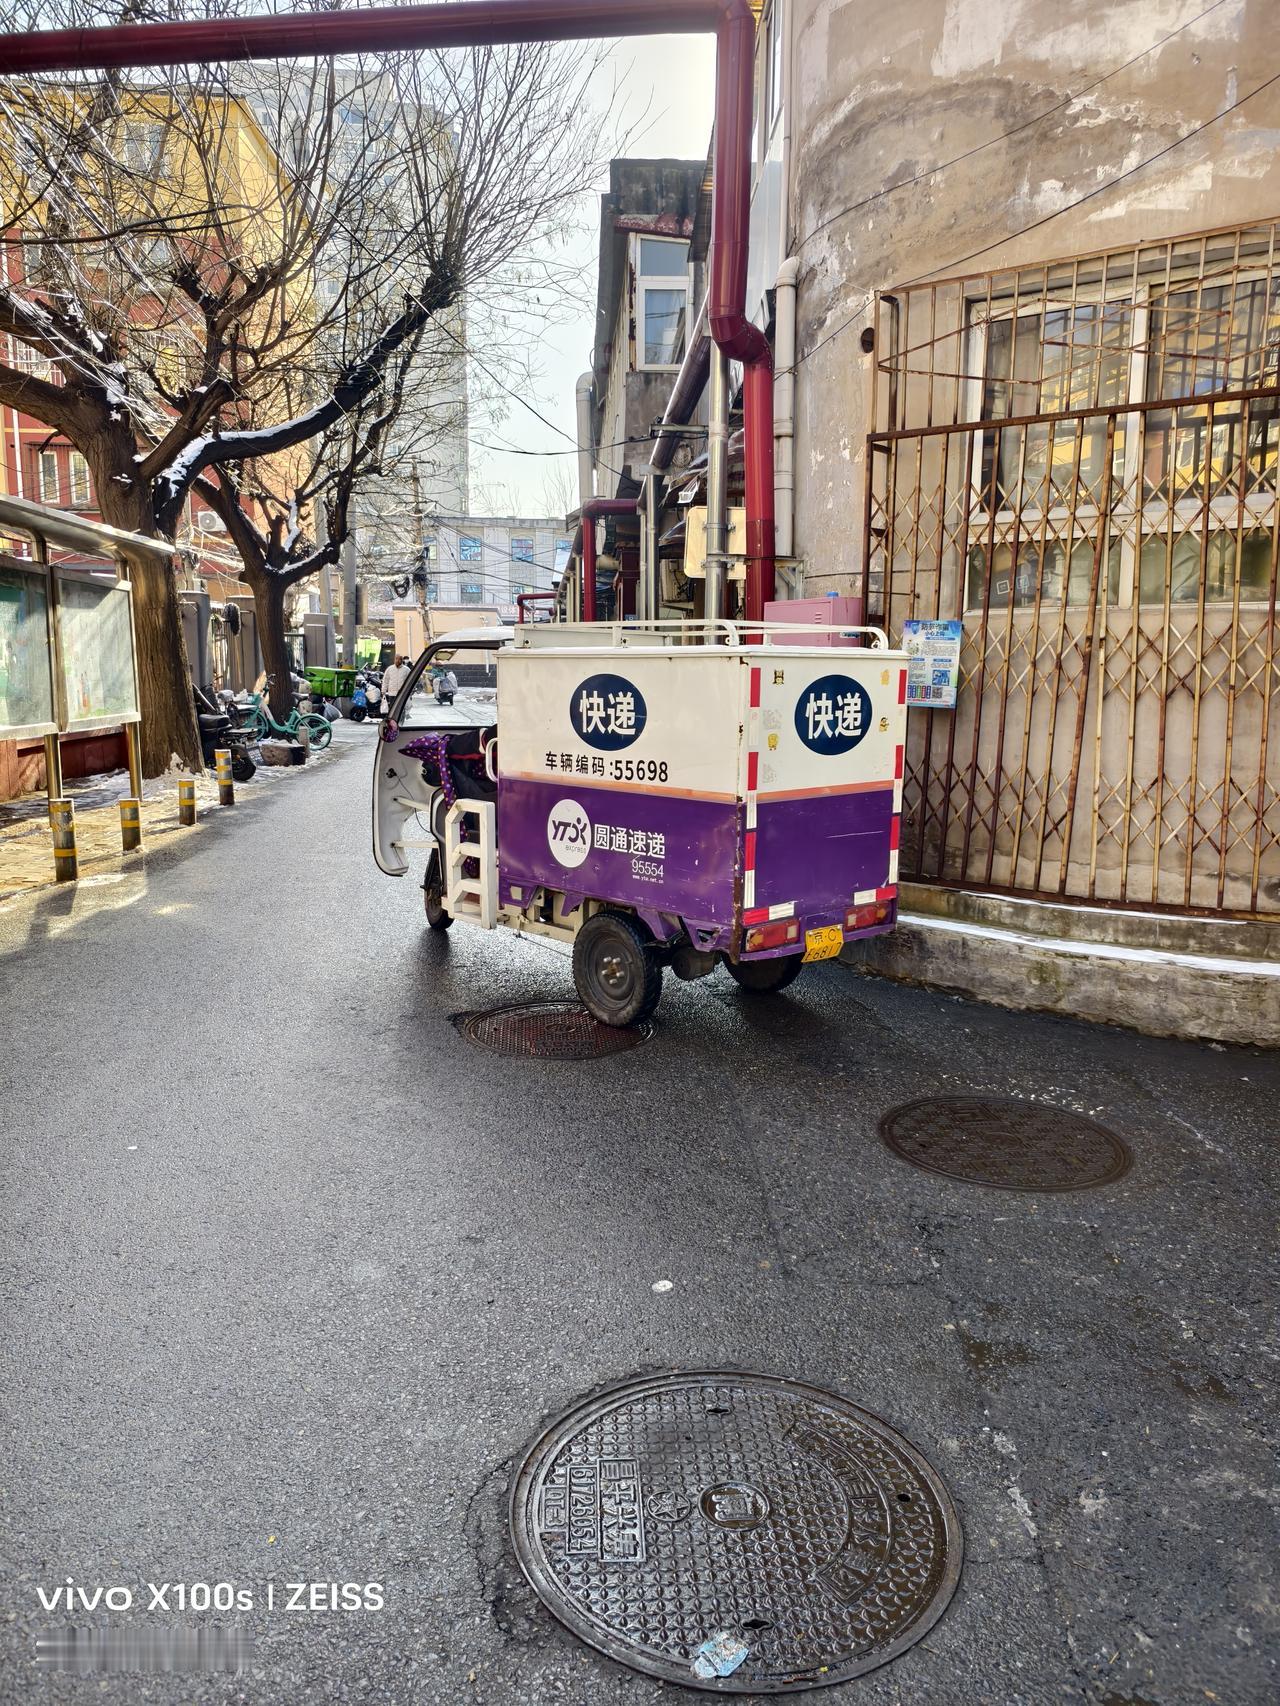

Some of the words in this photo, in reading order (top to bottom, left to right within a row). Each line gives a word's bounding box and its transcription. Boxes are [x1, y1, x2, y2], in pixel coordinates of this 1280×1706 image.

[579, 690, 636, 736] 快递
[804, 691, 862, 740] 快递
[594, 824, 665, 858] 圆通速递
[631, 860, 664, 877] 95554
[570, 1468, 596, 1550] 61726054
